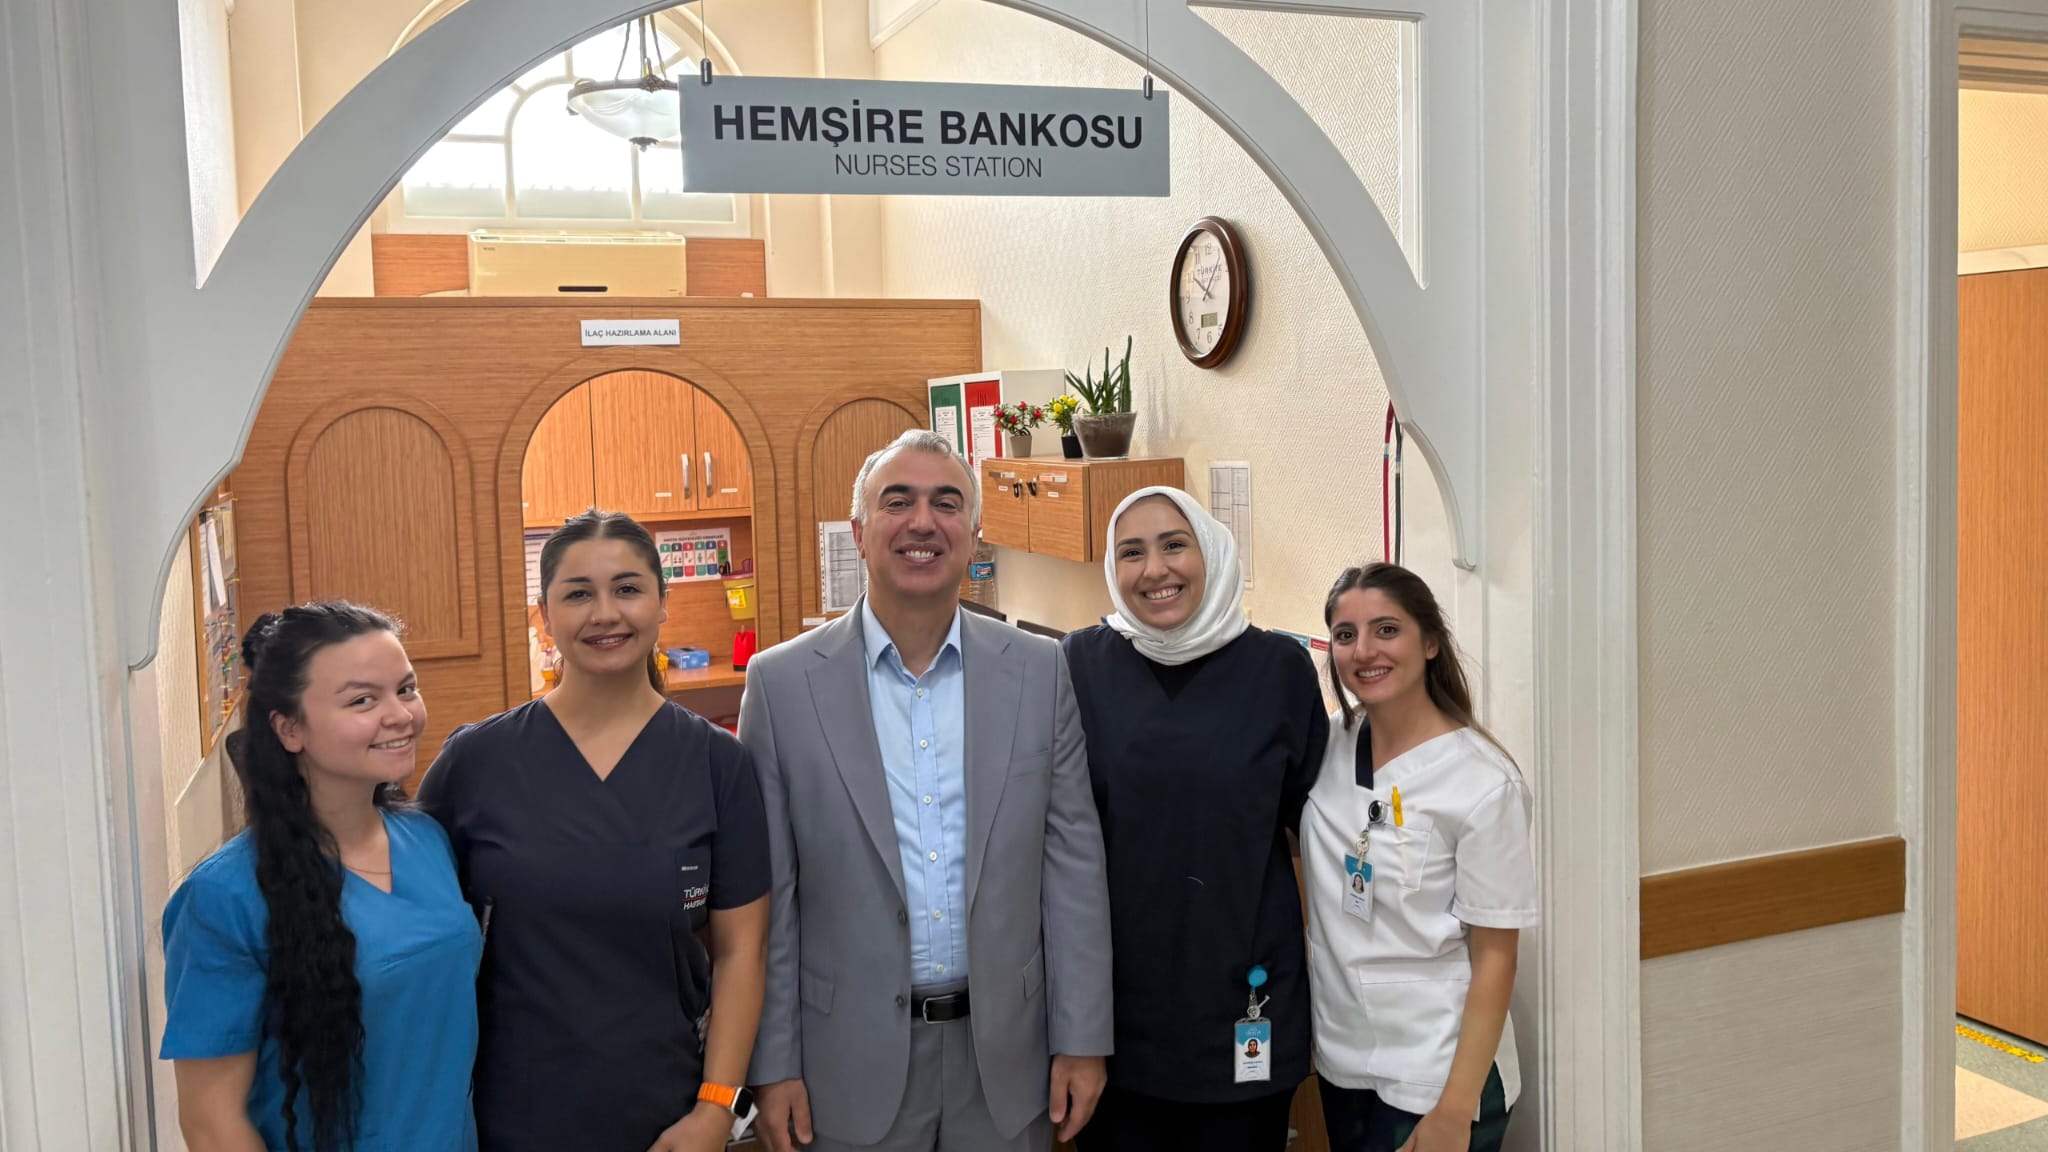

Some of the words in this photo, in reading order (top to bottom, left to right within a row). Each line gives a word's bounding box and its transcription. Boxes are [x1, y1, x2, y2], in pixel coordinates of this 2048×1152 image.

[714, 99, 924, 148] HEMŞİRE
[940, 110, 1142, 149] BANKOSU
[835, 154, 937, 176] NURSES
[945, 156, 1042, 178] STATION
[585, 328, 603, 338] İLAÇ
[605, 329, 652, 337] HAZIRLAMA
[653, 329, 677, 337] ALANI
[1207, 331, 1212, 344] 6
